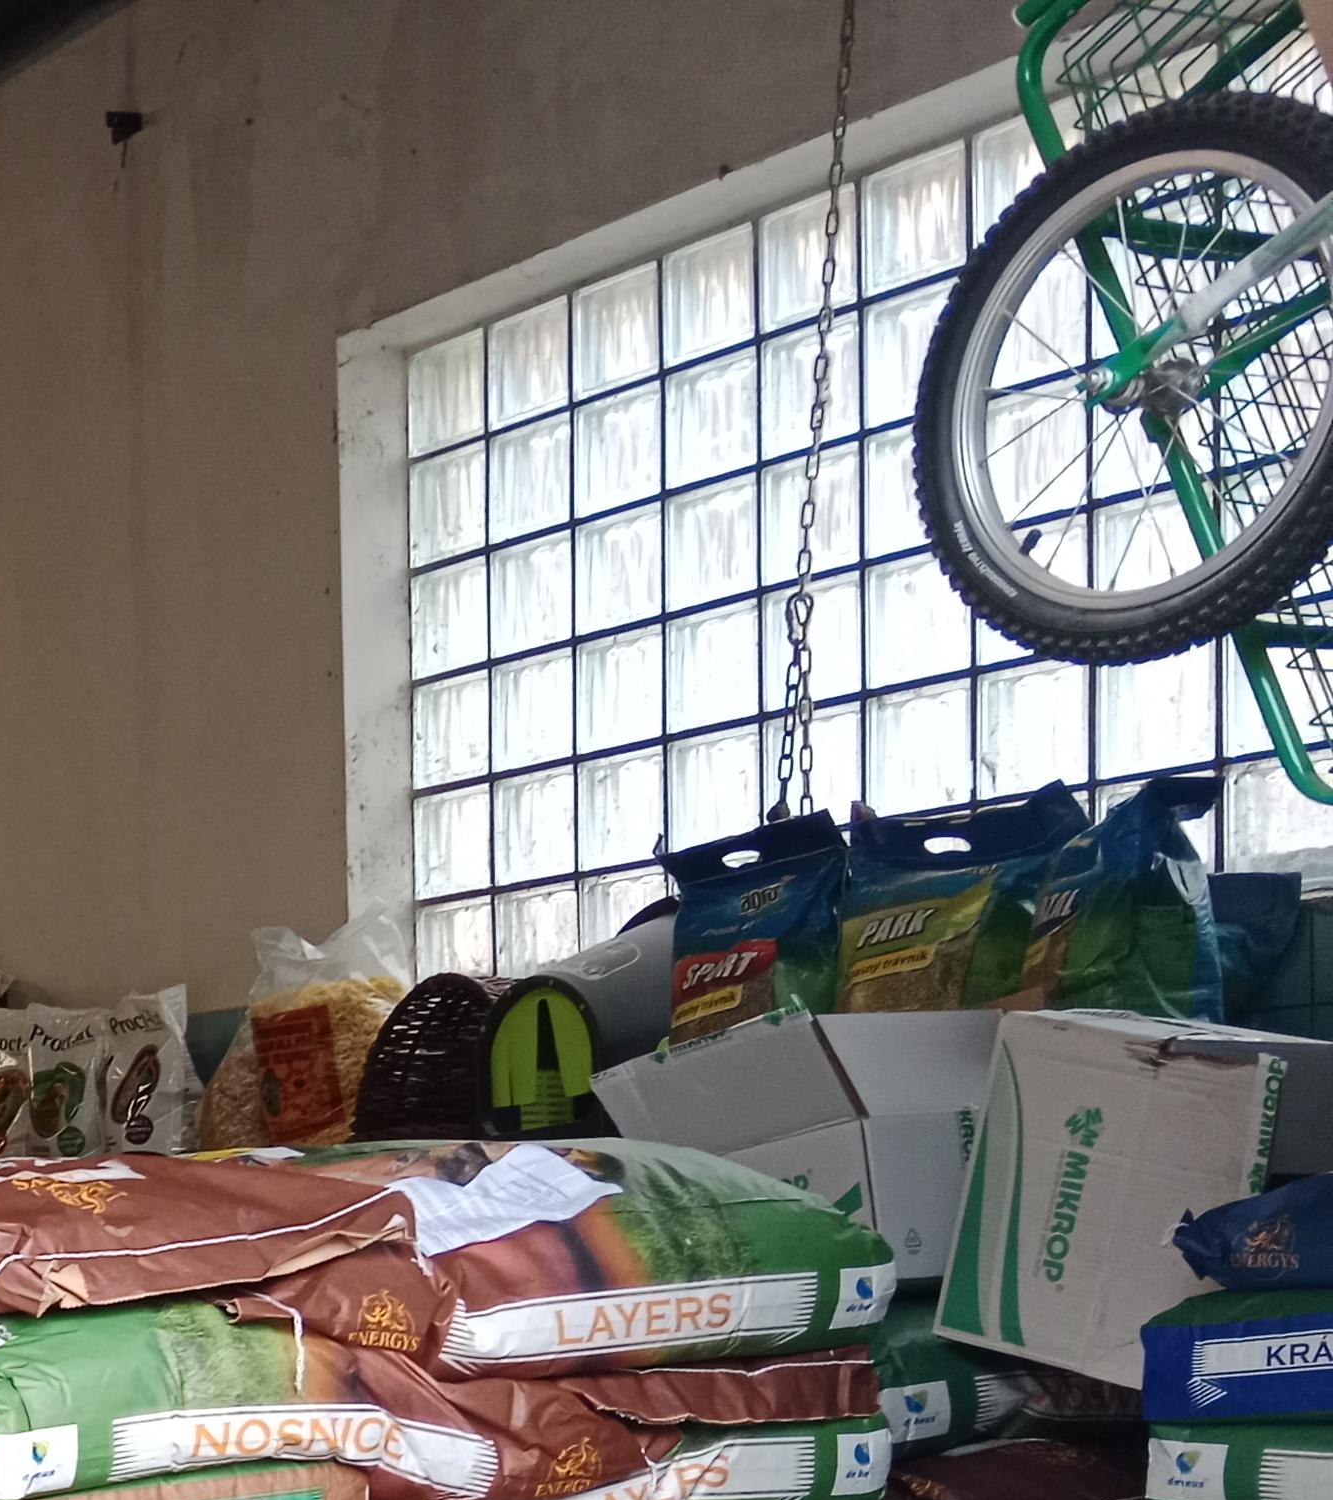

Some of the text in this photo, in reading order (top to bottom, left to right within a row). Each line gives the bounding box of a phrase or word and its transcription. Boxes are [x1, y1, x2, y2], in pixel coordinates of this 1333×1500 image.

[856, 908, 935, 949] PARK
[1257, 1057, 1285, 1158] MIKROP
[1042, 1151, 1090, 1283] MIKROP
[347, 1330, 420, 1351] ENERGYS
[555, 1293, 732, 1346] LAYERS
[193, 1416, 406, 1462] NOSNICE
